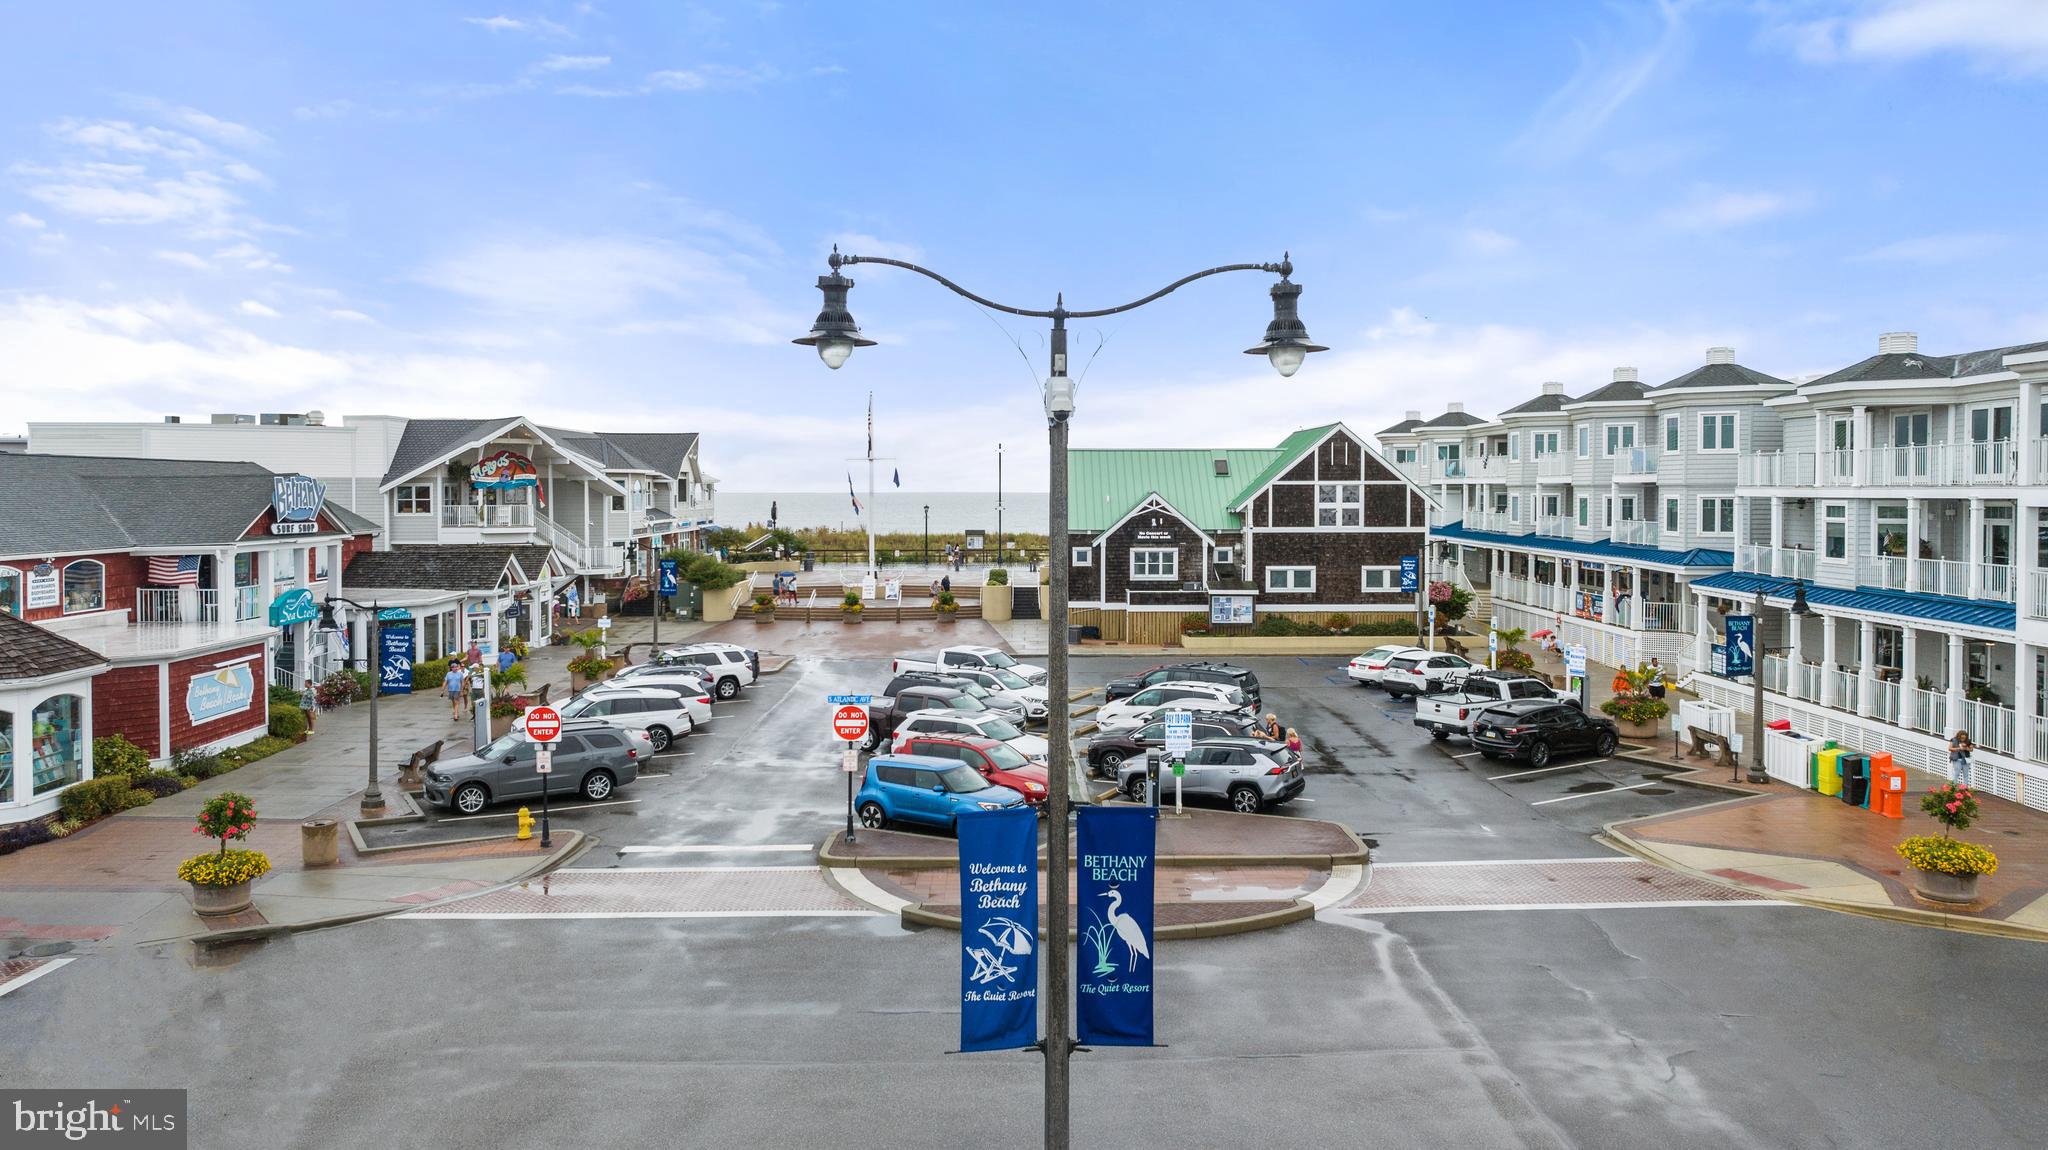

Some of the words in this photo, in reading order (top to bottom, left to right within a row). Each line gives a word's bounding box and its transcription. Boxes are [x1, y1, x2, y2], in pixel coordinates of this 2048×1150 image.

[277, 524, 294, 533] SURF
[299, 524, 315, 532] SHOP
[280, 605, 296, 623] Sea
[297, 602, 316, 619] Crest
[385, 640, 410, 648] Bethany
[1166, 713, 1174, 724] PAY
[1174, 713, 1180, 724] TO
[1181, 713, 1191, 724] PARK
[840, 727, 861, 735] ENTER
[1084, 855, 1148, 868] BETHANY
[969, 862, 1016, 875] Welcome
[1017, 863, 1028, 874] to
[1092, 868, 1138, 882] BEACH
[969, 877, 1029, 896] Bethany
[978, 894, 1021, 909] Beach
[964, 990, 982, 1002] The
[983, 990, 1007, 1002] Quiet
[1007, 988, 1036, 1001] Resort
[1080, 983, 1097, 994] The
[1097, 983, 1120, 996] Quiet
[1121, 983, 1151, 994] Resort
